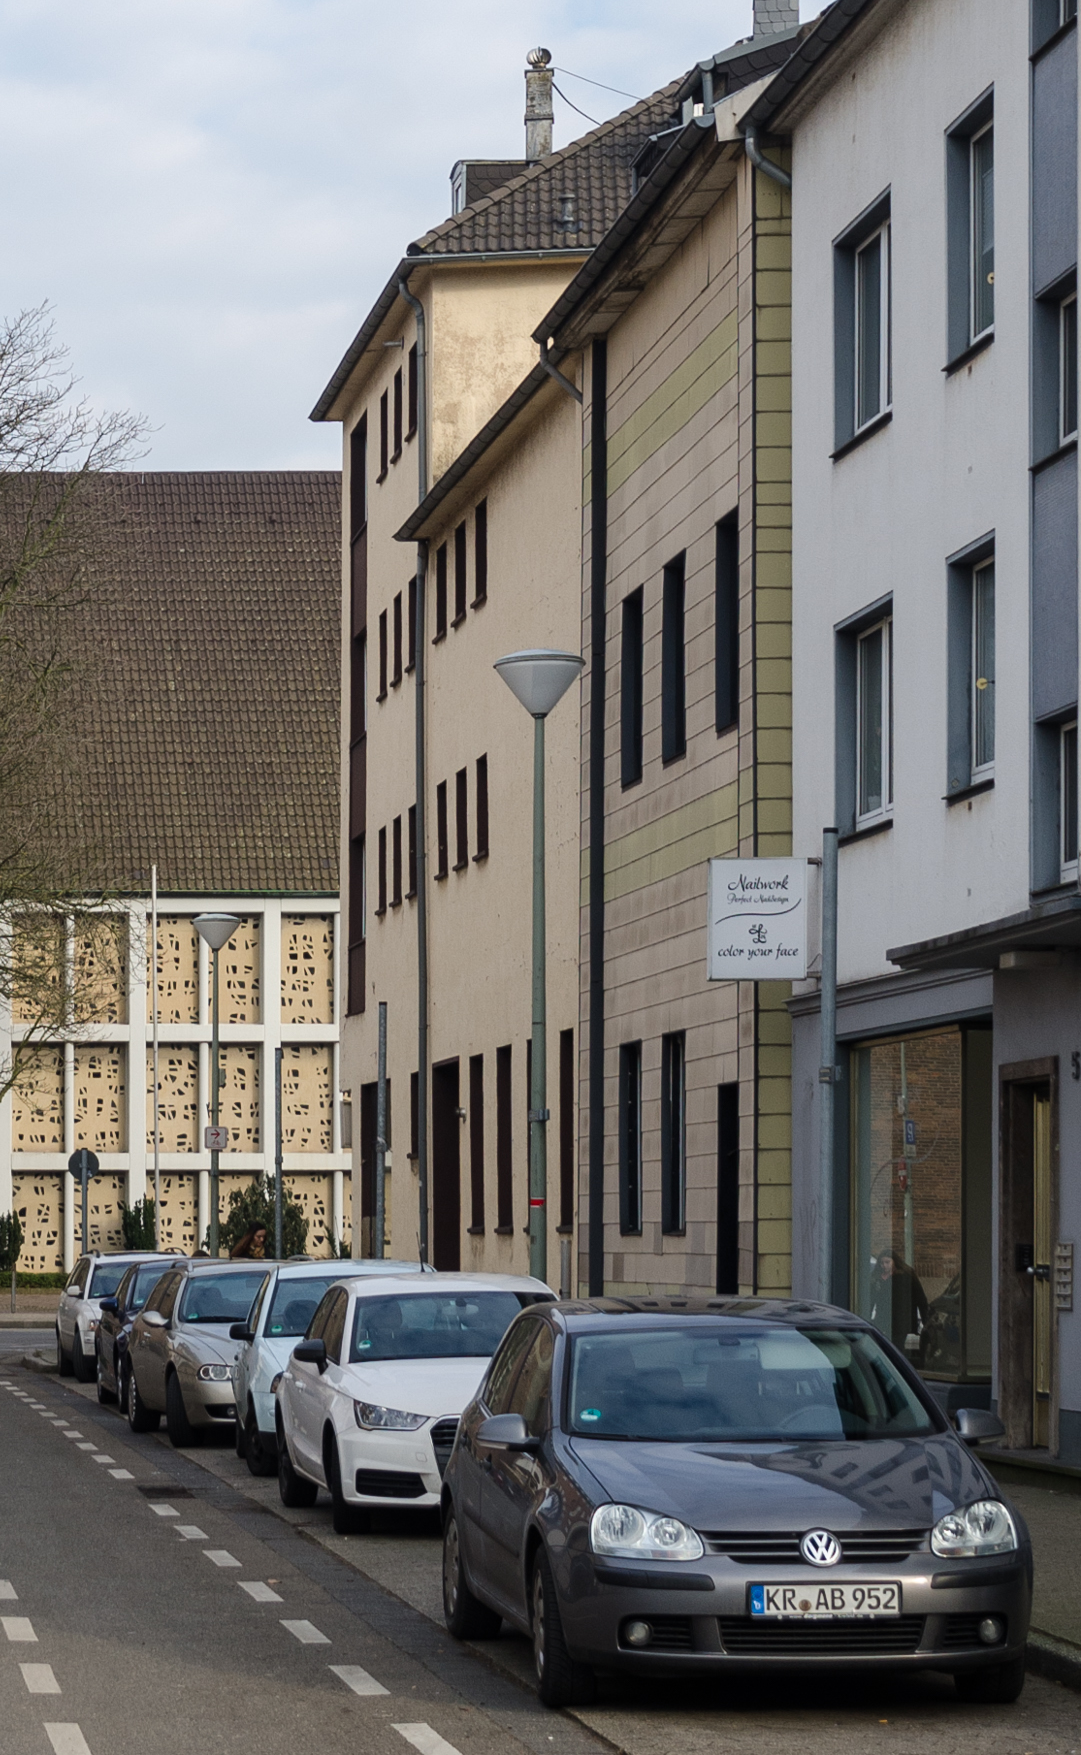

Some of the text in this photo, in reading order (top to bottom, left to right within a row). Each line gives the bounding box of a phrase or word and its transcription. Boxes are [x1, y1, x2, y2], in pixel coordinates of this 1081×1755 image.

[727, 873, 789, 892] Nailwork
[726, 892, 752, 905] Perfect
[717, 943, 799, 960] color your face
[766, 1588, 797, 1611] KR
[815, 1588, 845, 1610] AB
[852, 1587, 896, 1610] 952
